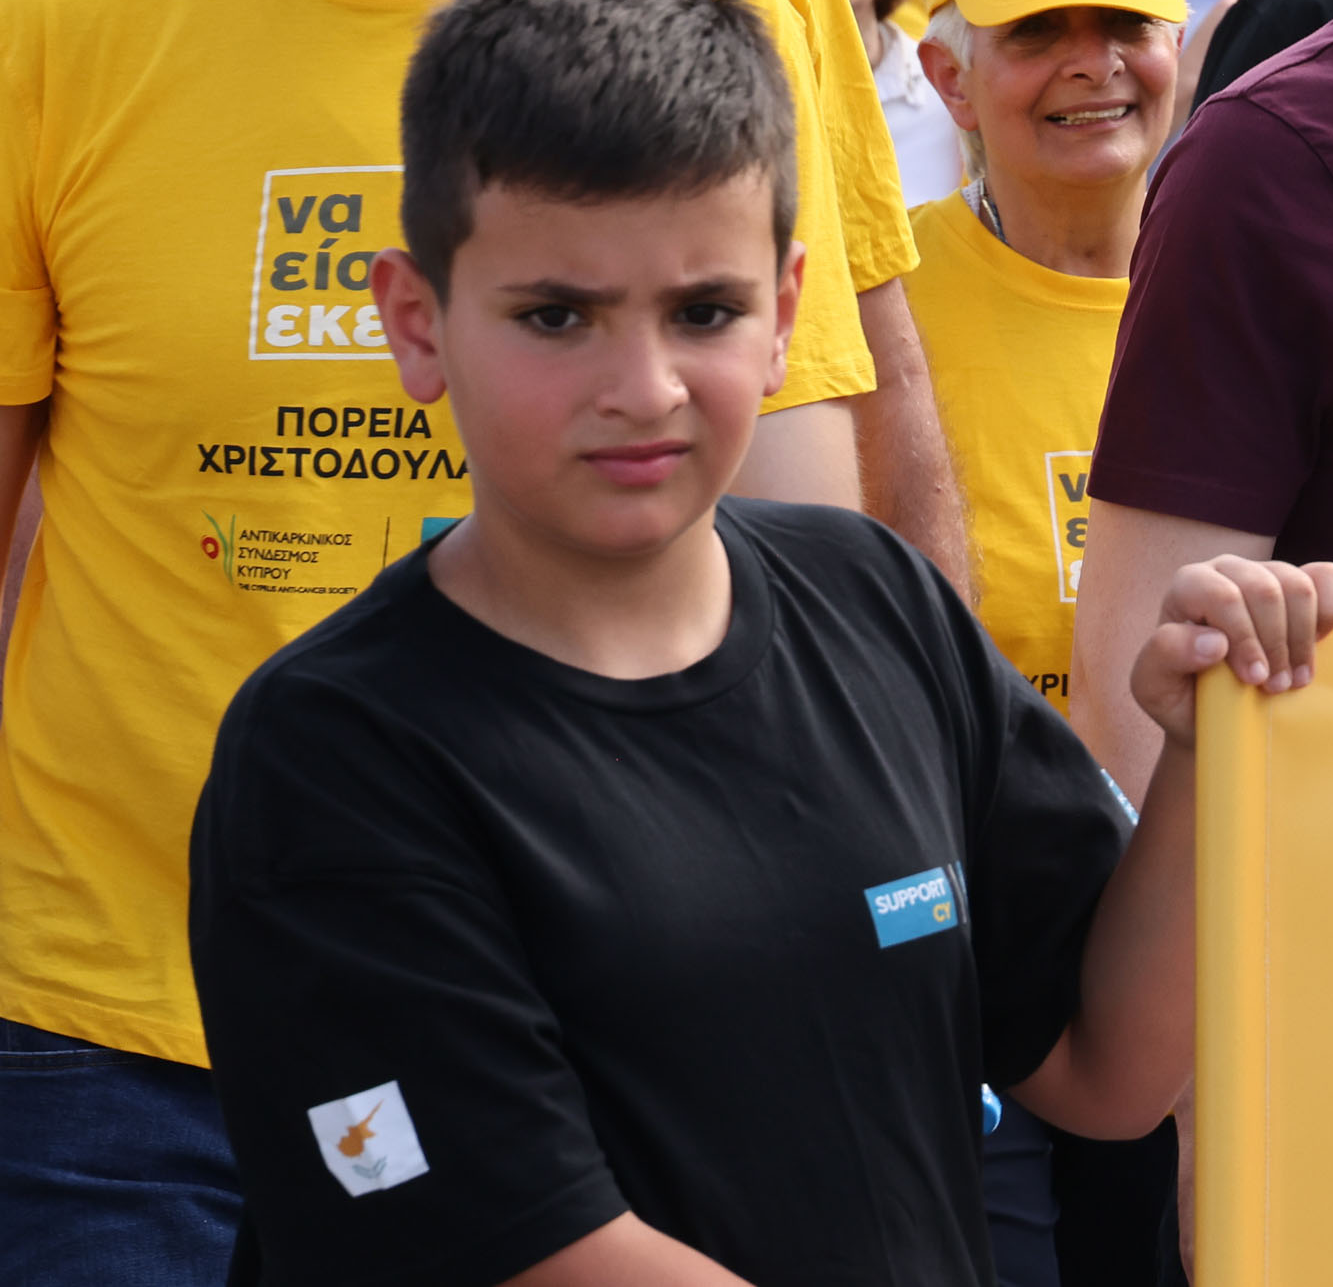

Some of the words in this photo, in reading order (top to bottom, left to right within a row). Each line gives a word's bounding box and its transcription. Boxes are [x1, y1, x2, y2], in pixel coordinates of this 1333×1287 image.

[277, 194, 363, 234] να
[270, 238, 378, 291] είσ
[264, 304, 389, 347] εκε
[277, 406, 431, 439] ΠΟΡΕΙΑ
[198, 444, 471, 480] ΧΡΙΣΤΟΔΟΥΛ
[239, 529, 353, 546] ΑΝΤΙΚΑΡΚΙΝΙΚΟΣ
[238, 547, 319, 563] ΣΥΝΔΕΣΜΟΣ
[237, 565, 291, 580] ΚΥΠΡΟΥ
[874, 877, 947, 915] SUPPORT
[933, 901, 951, 923] CY
